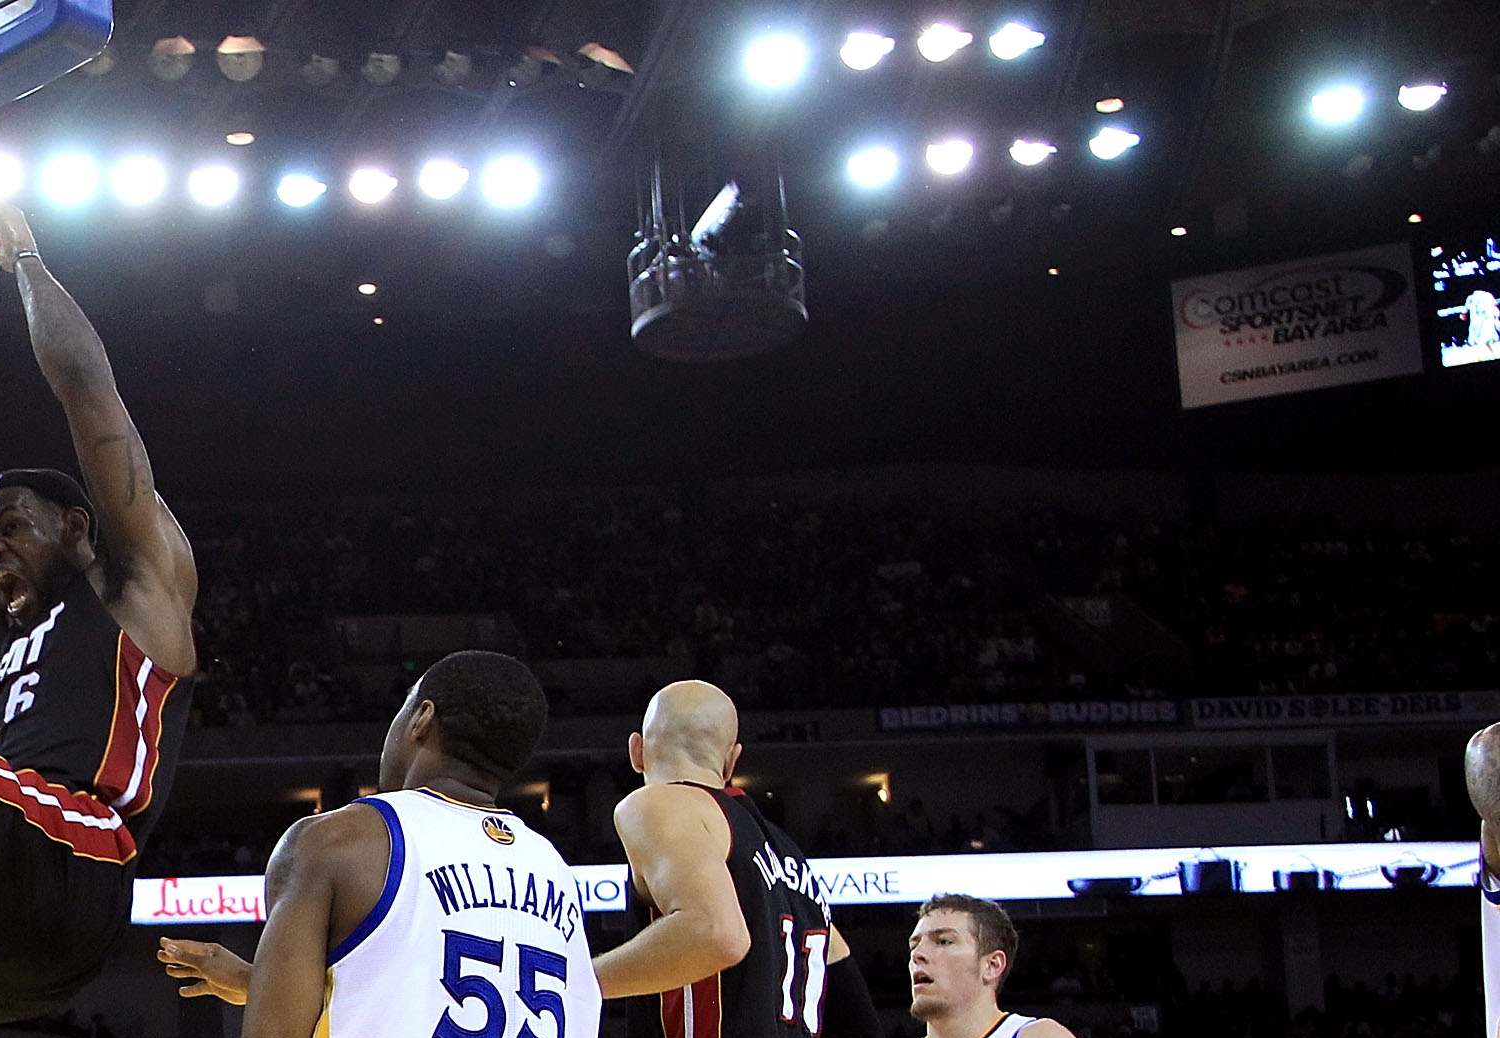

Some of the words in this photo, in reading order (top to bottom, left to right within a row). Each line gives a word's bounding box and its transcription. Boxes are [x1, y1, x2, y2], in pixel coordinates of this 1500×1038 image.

[1273, 324, 1320, 344] BAY
[1322, 310, 1388, 337] AREA
[3, 671, 40, 724] 6
[152, 877, 262, 922] Lucky
[425, 863, 579, 943] WILLIAMS
[818, 870, 900, 896] WARE
[781, 913, 829, 1037] 11
